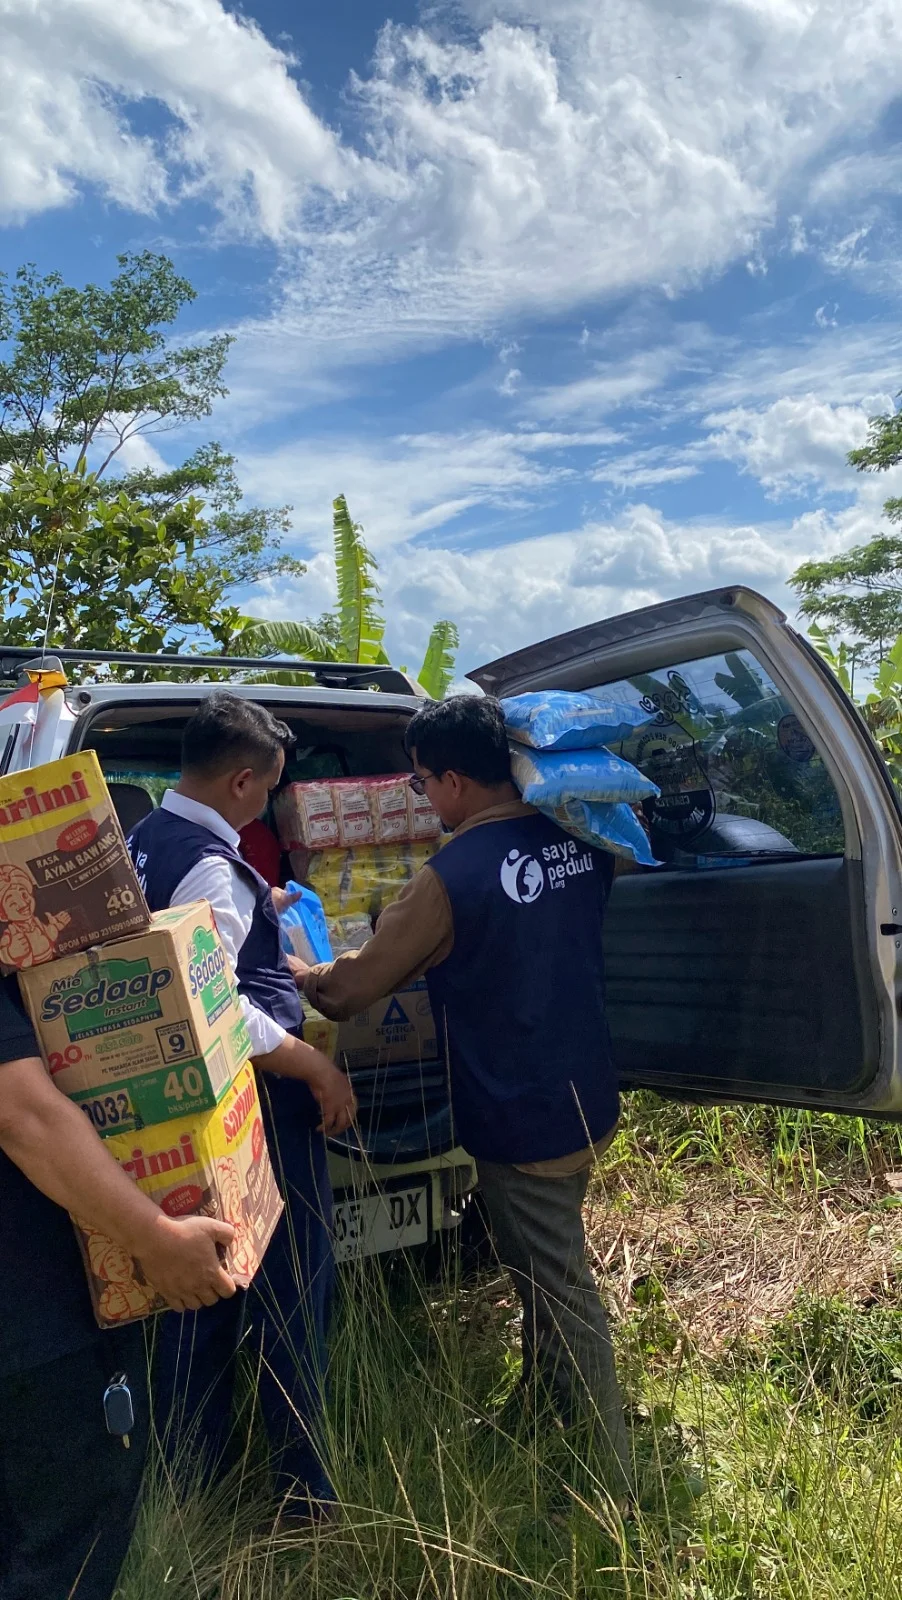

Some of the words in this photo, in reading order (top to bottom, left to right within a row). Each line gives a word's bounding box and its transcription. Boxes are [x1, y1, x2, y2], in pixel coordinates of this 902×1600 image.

[44, 860, 76, 881] AYAM
[75, 831, 117, 866] BAWANG
[542, 840, 578, 861] saya
[36, 855, 60, 869] RASA
[547, 852, 594, 889] peduli
[104, 884, 130, 897] ISI
[106, 890, 135, 910] 40
[108, 903, 138, 917] BKS
[58, 938, 80, 953] BPOM
[88, 929, 100, 940] MD
[188, 946, 227, 999] Sedaap
[40, 967, 174, 1022] Sedaap
[50, 976, 82, 993] Mie
[104, 998, 147, 1019] Instant
[75, 1030, 95, 1041] JELAS
[96, 1023, 121, 1036] TERASA
[168, 1033, 186, 1054] 9
[47, 1044, 83, 1076] 20
[163, 1065, 204, 1101] 40
[168, 1096, 209, 1114] bks/packs
[389, 1193, 422, 1230] DX
